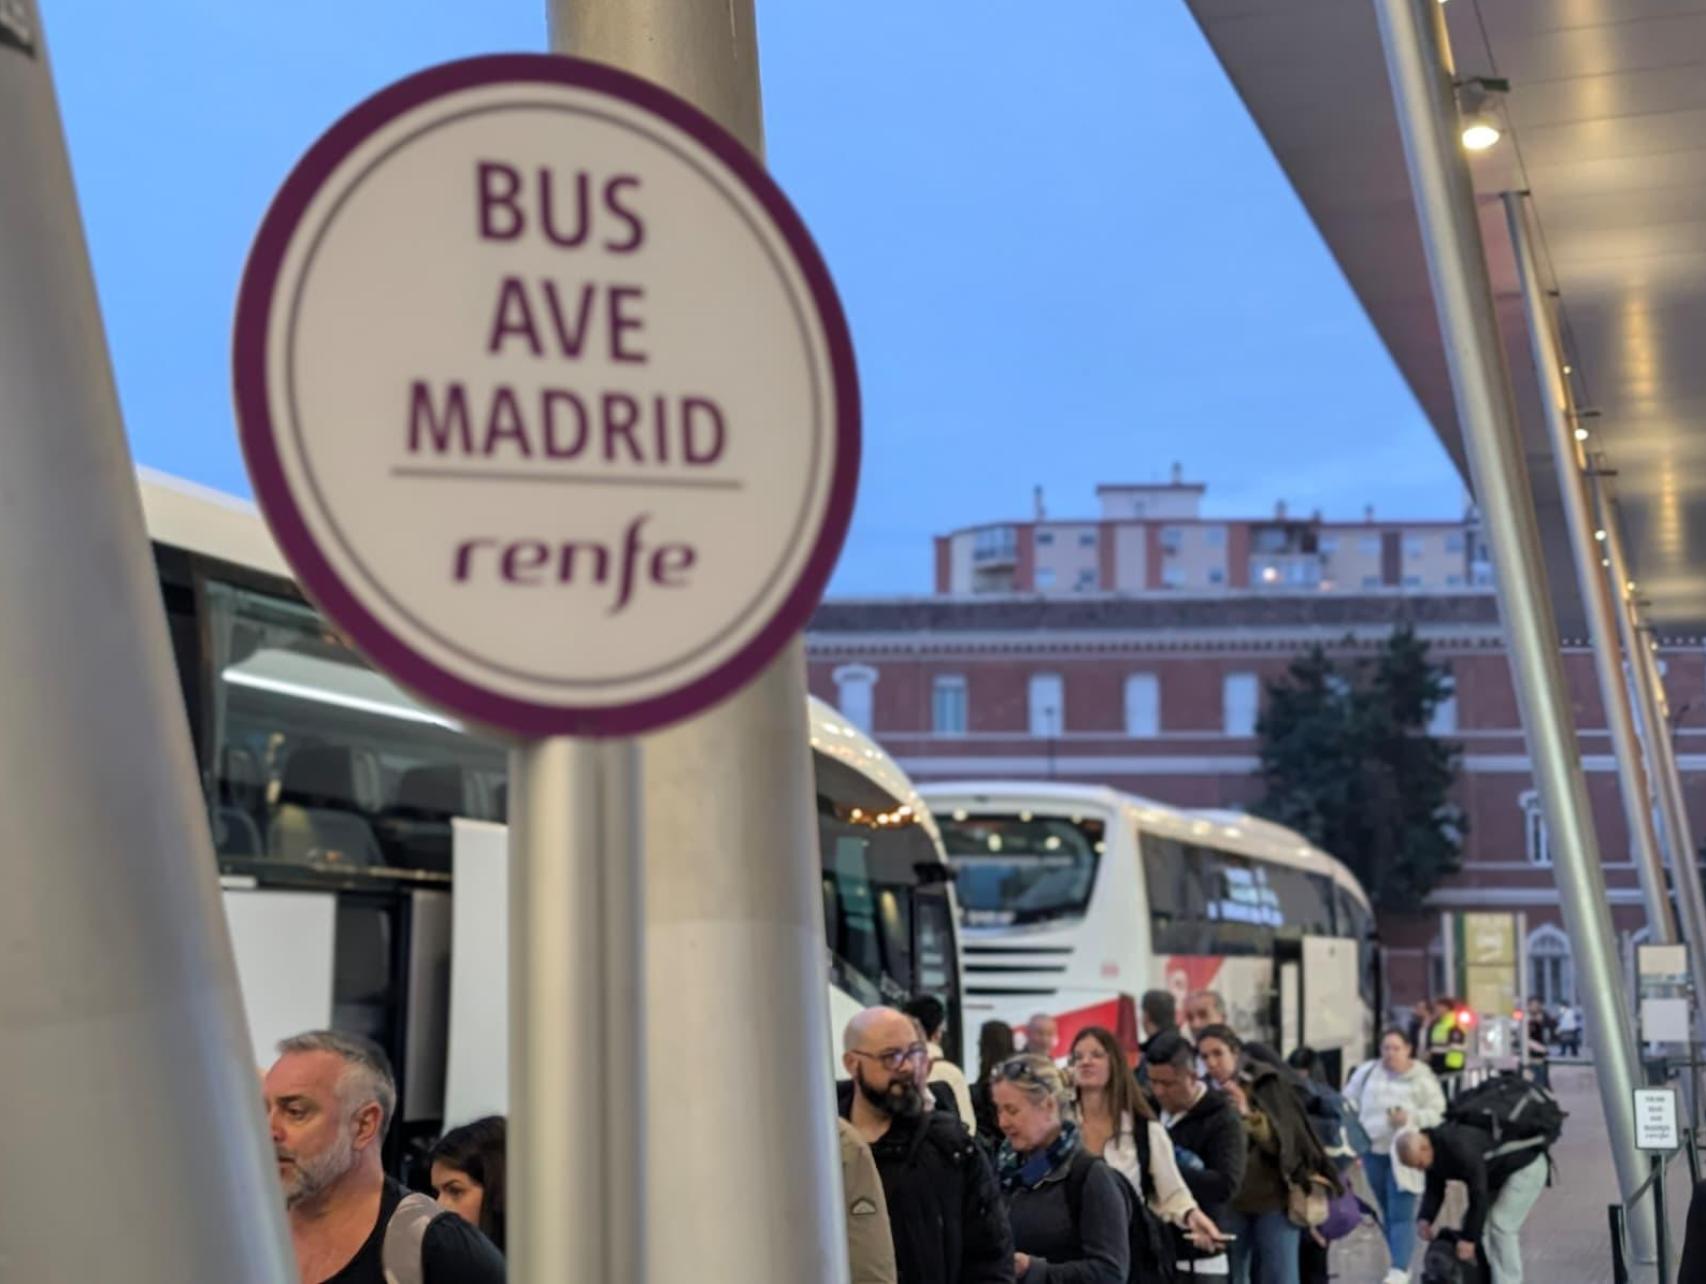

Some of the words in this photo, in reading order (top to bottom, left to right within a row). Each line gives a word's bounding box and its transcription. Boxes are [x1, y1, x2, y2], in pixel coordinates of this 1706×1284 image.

[475, 160, 647, 255] BUS
[487, 275, 649, 365] AVE
[406, 379, 728, 467] MADRID
[451, 513, 698, 616] renfe
